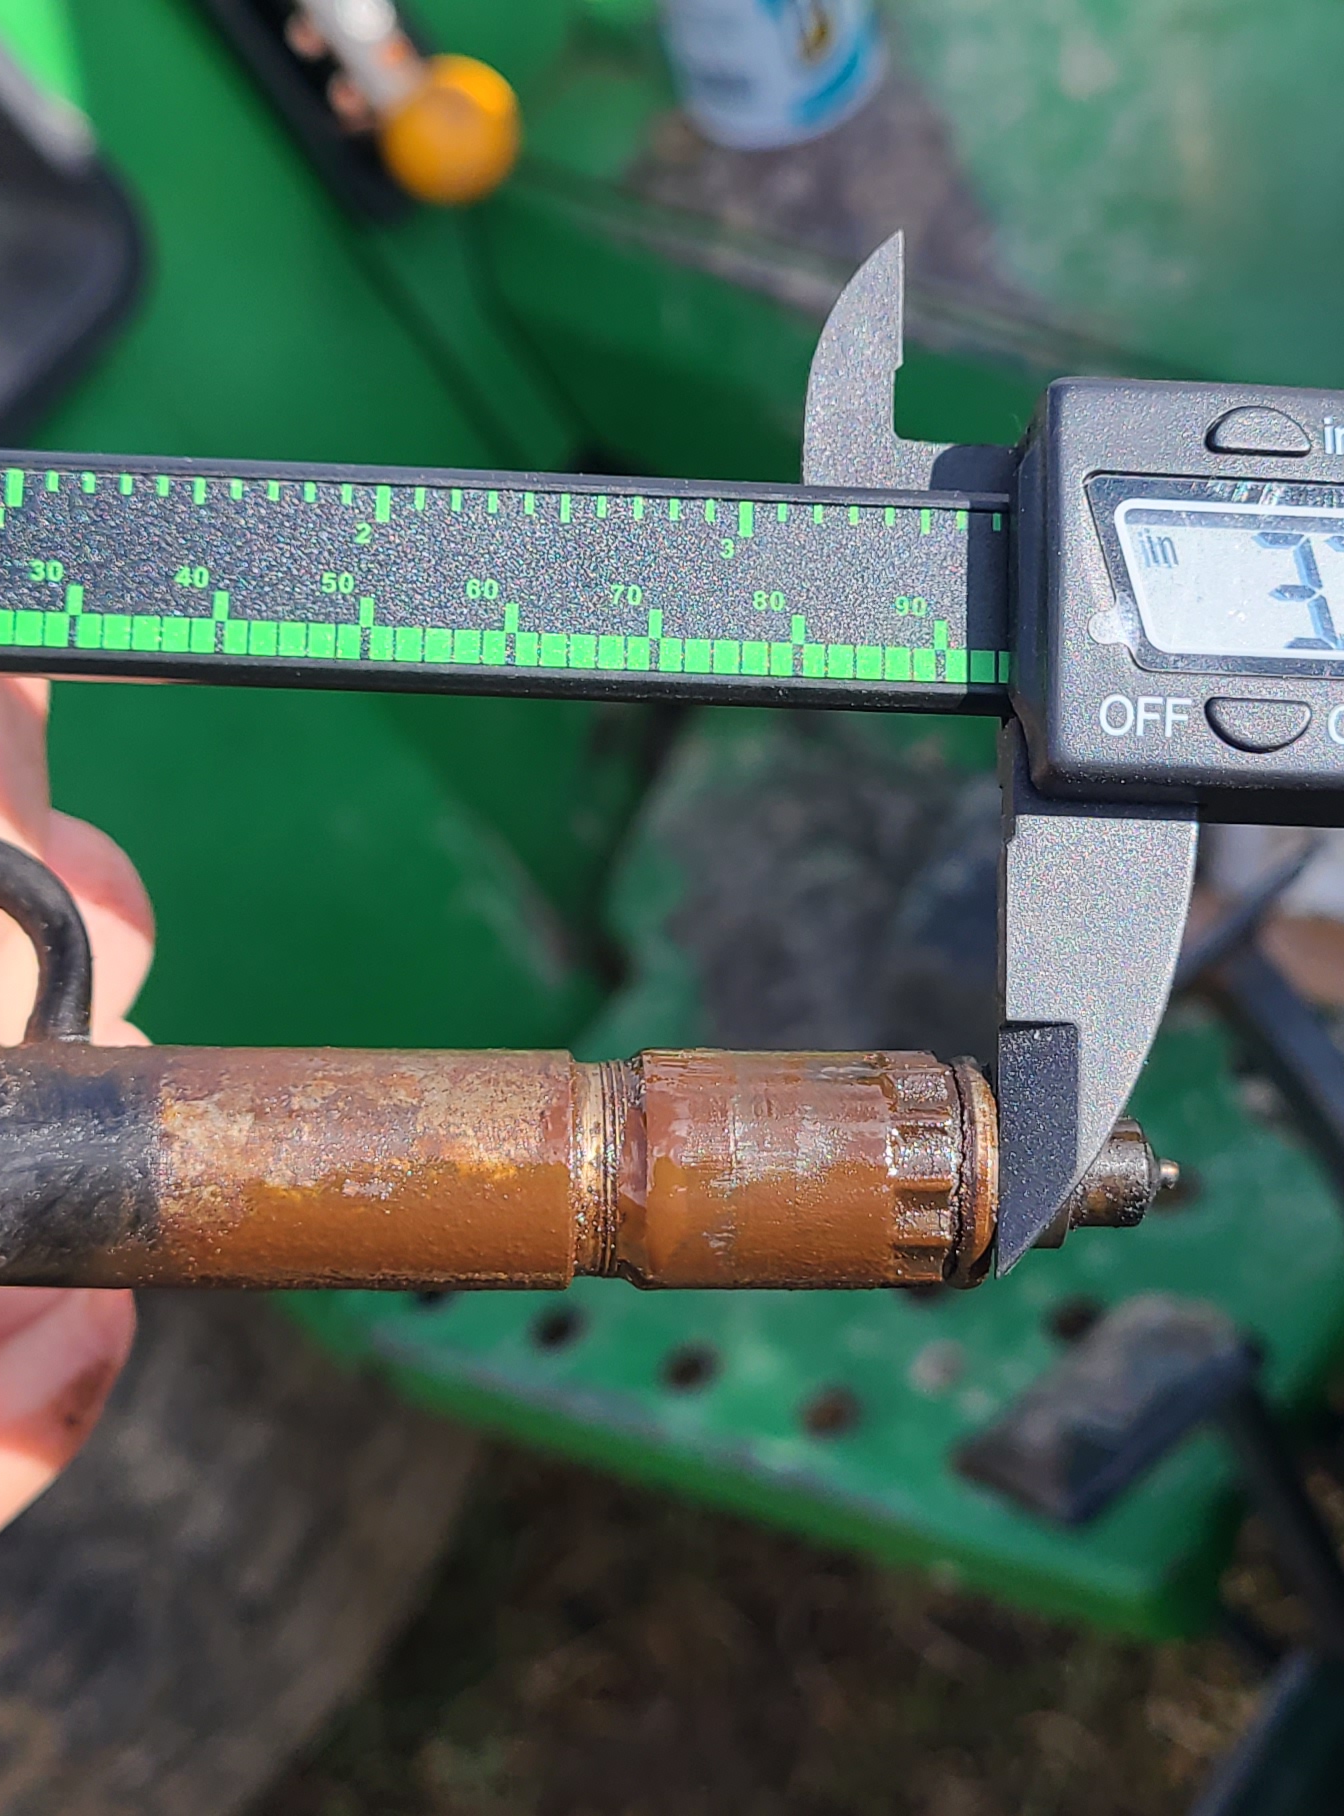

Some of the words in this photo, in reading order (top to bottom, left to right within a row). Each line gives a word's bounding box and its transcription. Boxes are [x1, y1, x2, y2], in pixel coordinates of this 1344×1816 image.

[355, 522, 371, 544] 2
[720, 538, 735, 560] 3
[1138, 529, 1179, 569] in
[29, 558, 64, 583] 30
[174, 566, 210, 589] 40
[322, 571, 356, 595] 50
[466, 578, 499, 601] 60
[611, 584, 643, 607] 70
[754, 590, 787, 613] 80
[894, 596, 928, 618] 90
[1099, 695, 1193, 738] OFF
